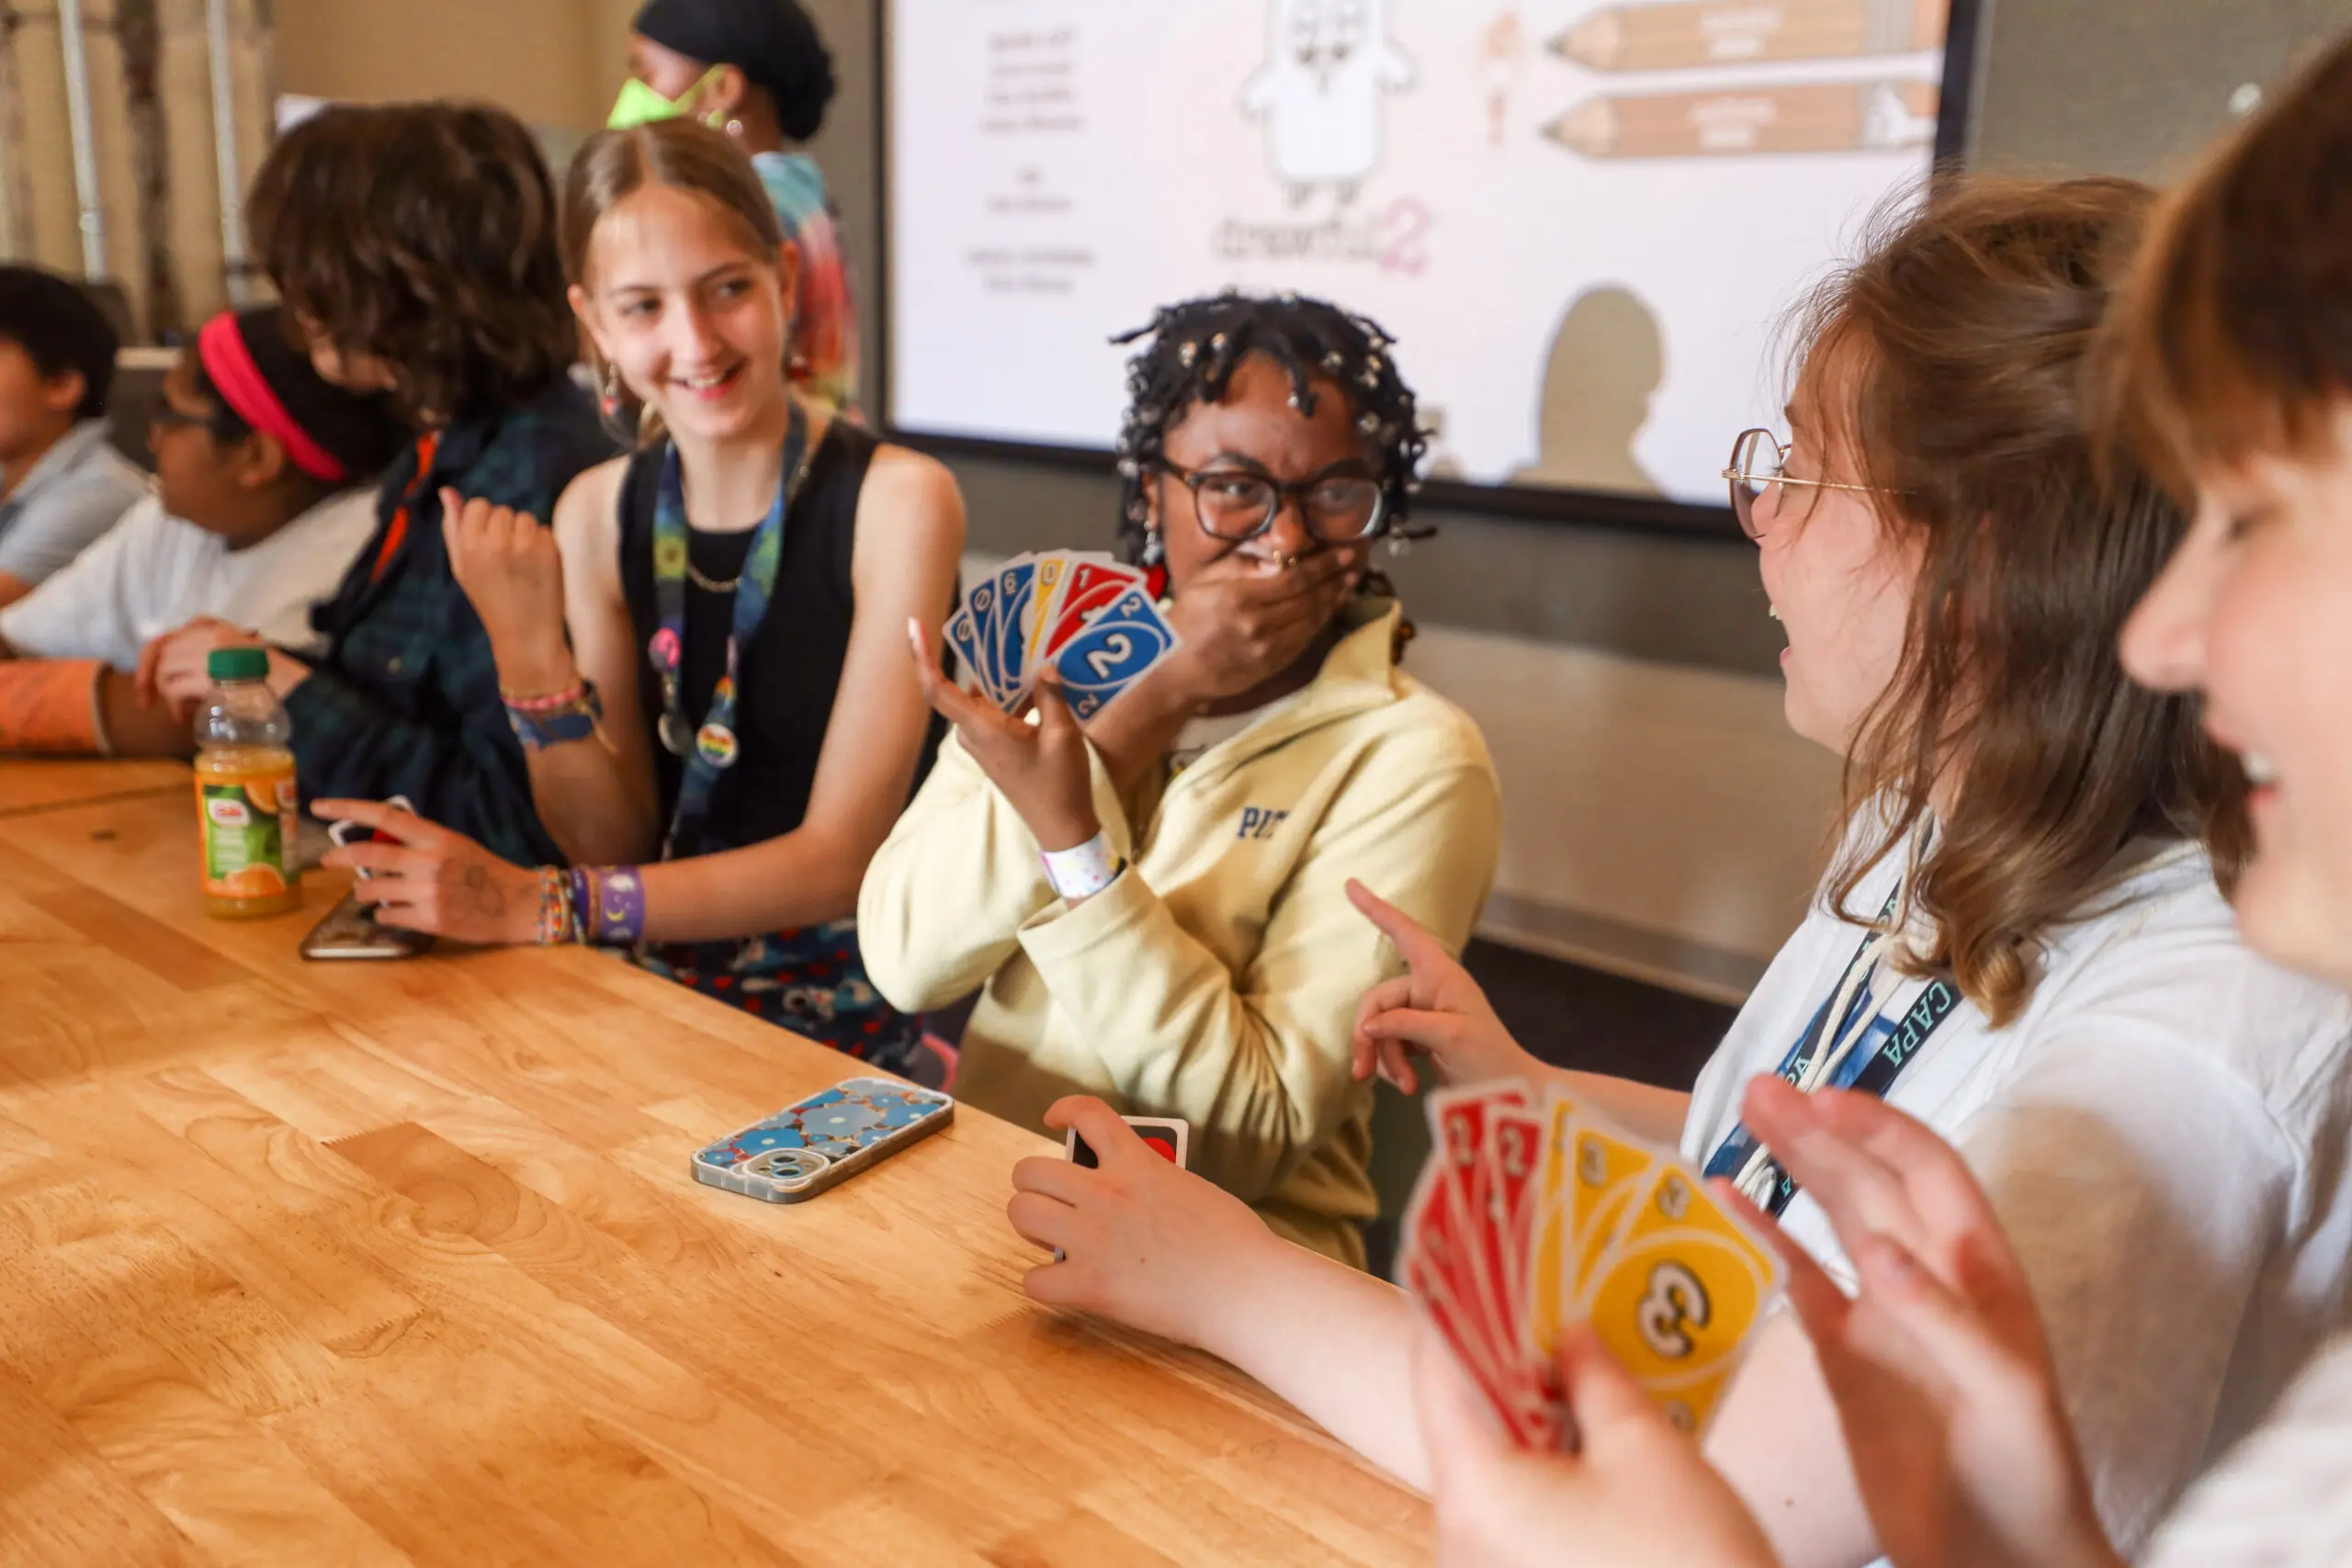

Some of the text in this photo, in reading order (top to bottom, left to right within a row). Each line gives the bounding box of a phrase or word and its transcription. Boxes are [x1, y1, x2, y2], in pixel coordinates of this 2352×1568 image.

[1378, 194, 1431, 276] 2
[1119, 596, 1142, 619] 2
[1085, 632, 1133, 681] 2
[1882, 980, 1951, 1068] CAPA
[1635, 1258, 1711, 1359] 3
